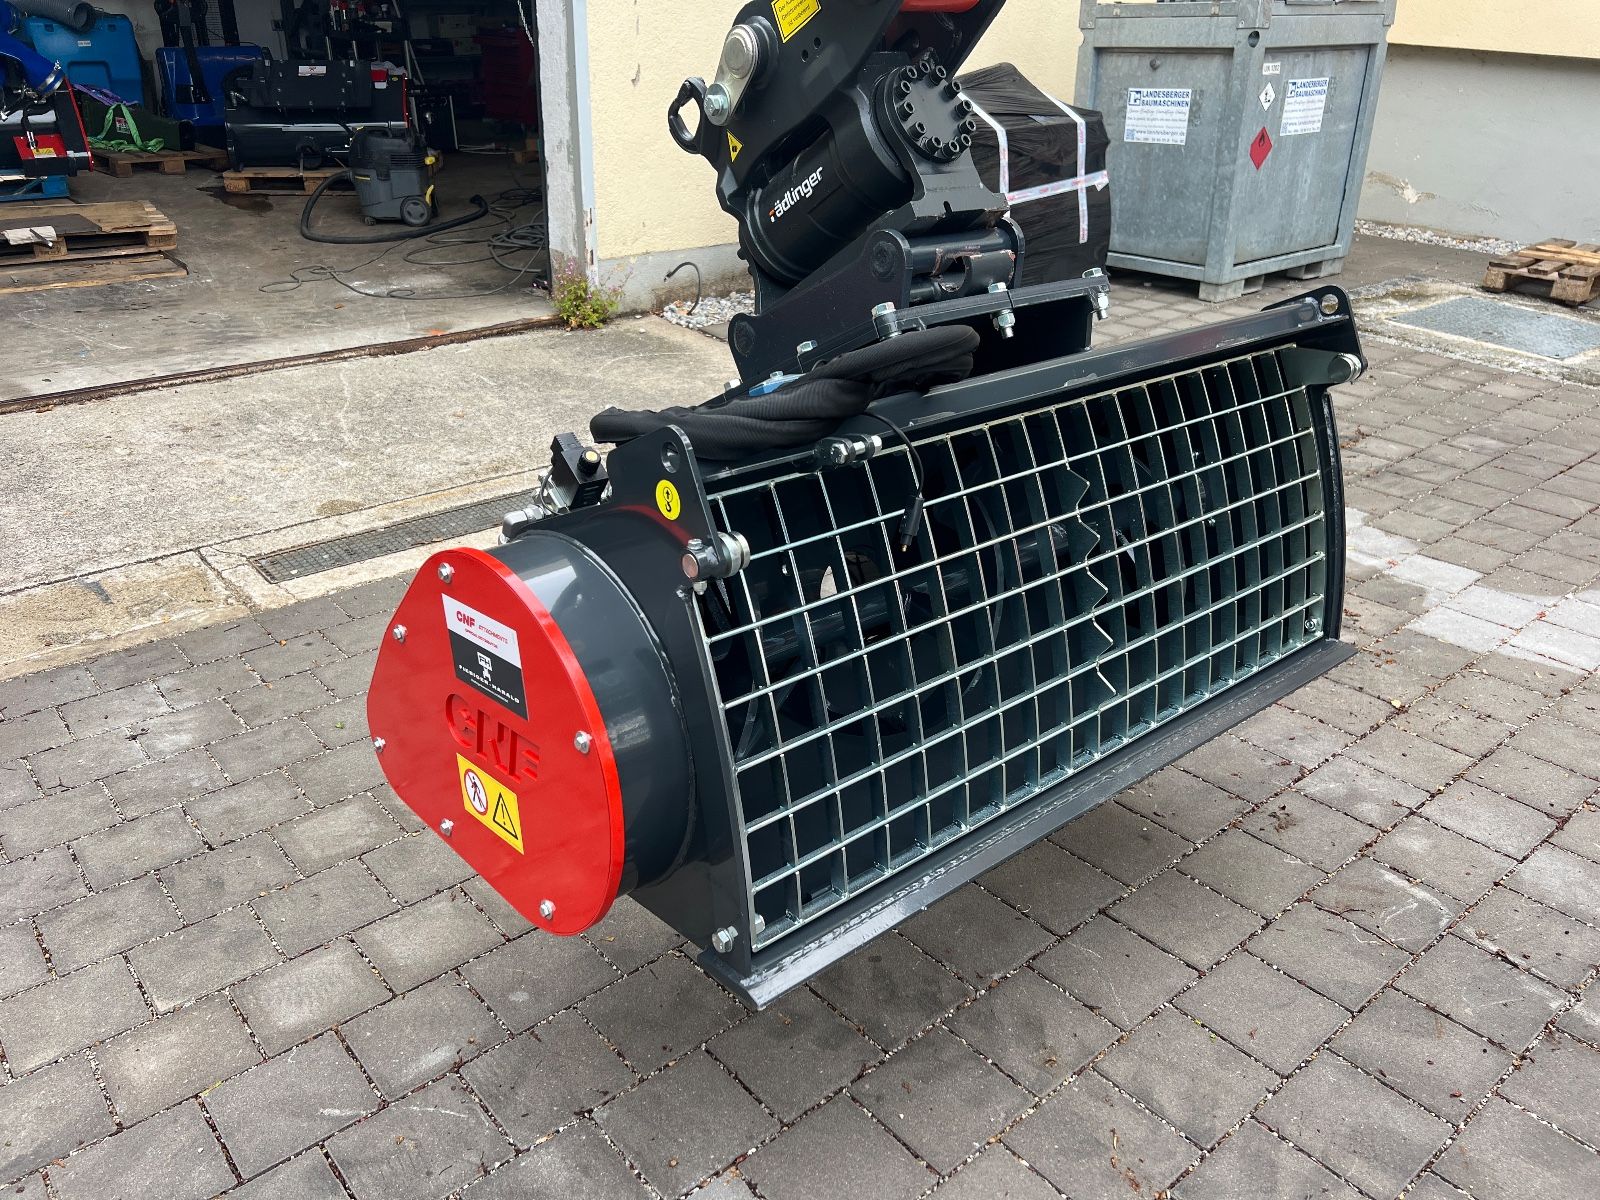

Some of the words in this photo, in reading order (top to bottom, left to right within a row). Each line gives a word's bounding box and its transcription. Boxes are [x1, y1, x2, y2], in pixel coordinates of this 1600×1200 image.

[1264, 65, 1271, 73] UN
[1297, 79, 1328, 89] LANDESBERGER
[1142, 90, 1190, 99] LANDESBERGER
[1295, 89, 1326, 98] BAUMASCHINEN
[1141, 99, 1189, 107] BAUMASCHINEN
[768, 166, 823, 223] rädlinger
[456, 610, 476, 628] CNF
[445, 693, 541, 784] CNF
